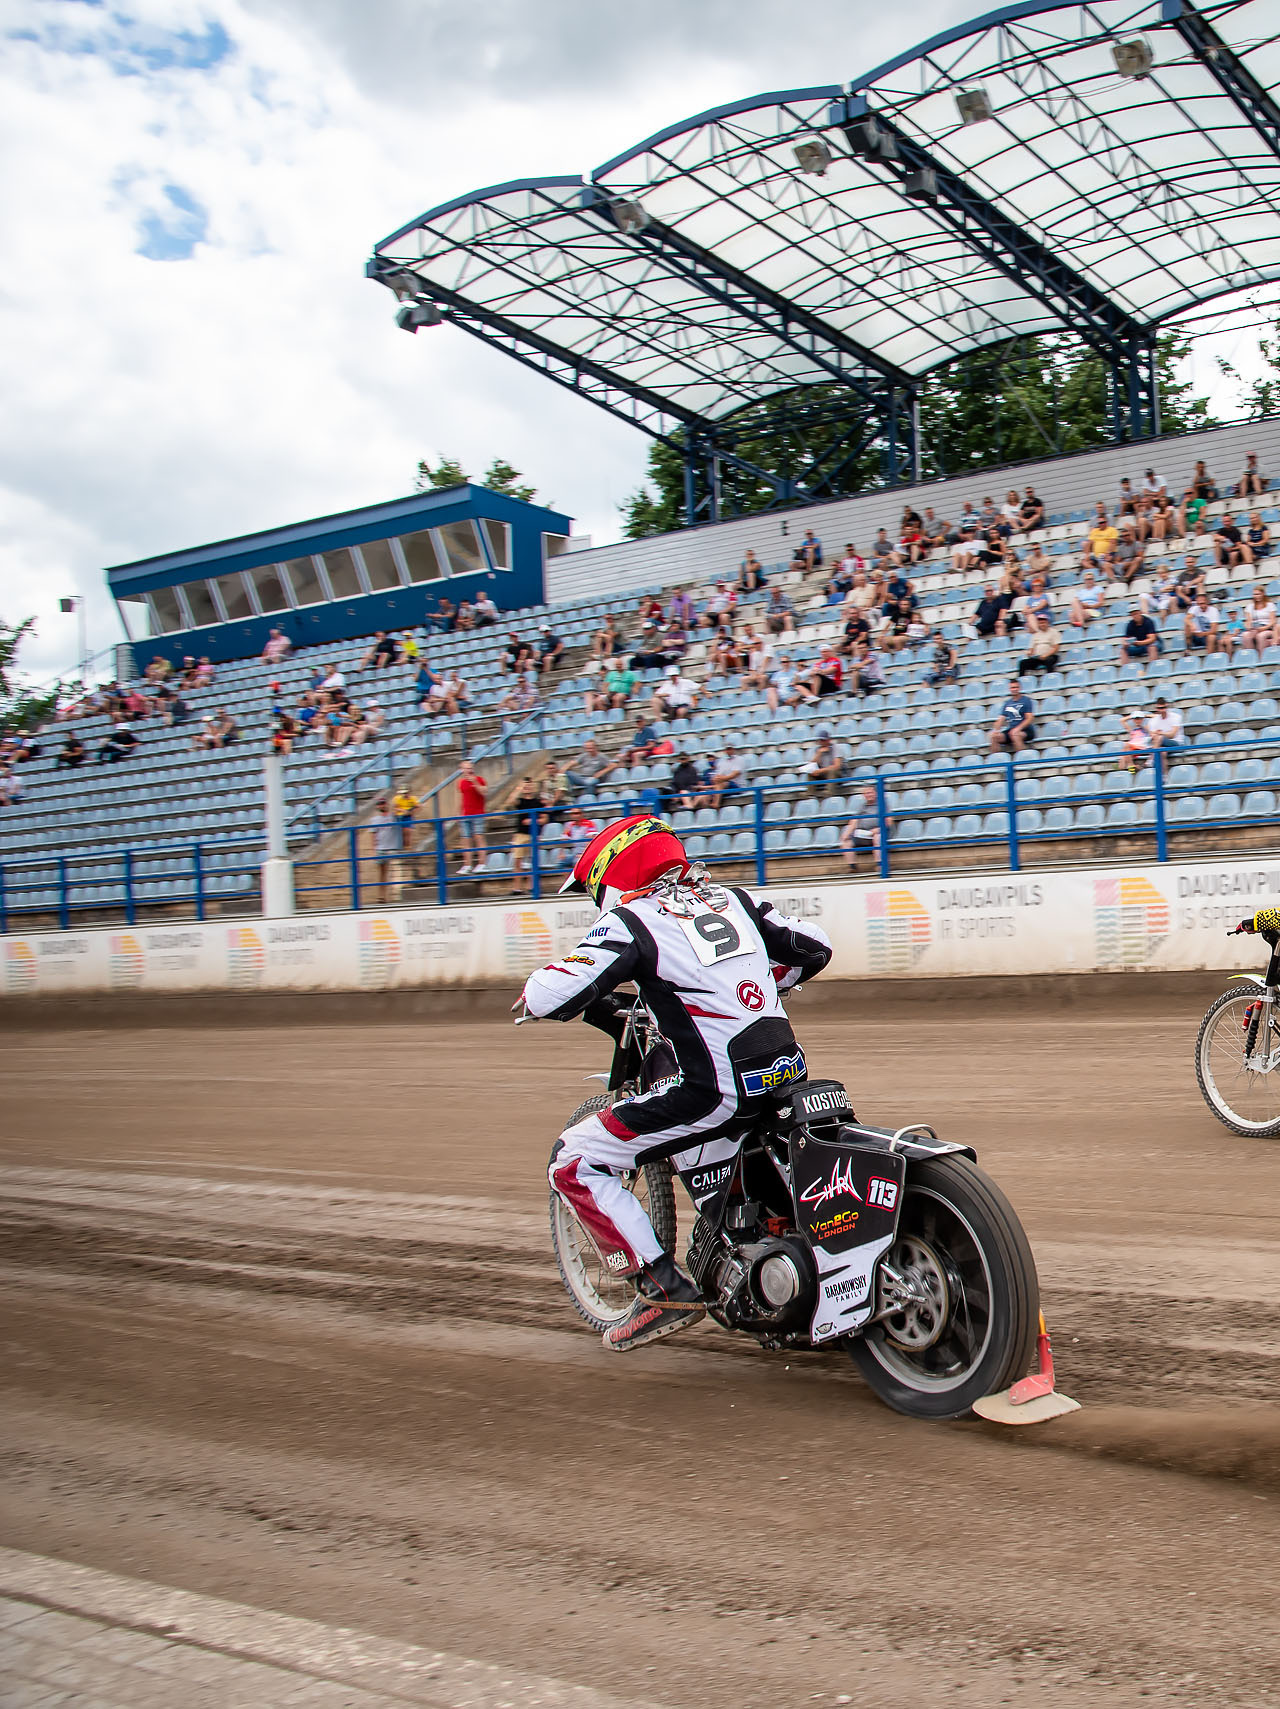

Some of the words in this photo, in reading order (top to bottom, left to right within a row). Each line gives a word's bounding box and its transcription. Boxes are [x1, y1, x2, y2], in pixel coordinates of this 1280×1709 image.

[694, 913, 740, 957] 9
[869, 1179, 897, 1208] 113
[818, 1222, 855, 1240] LONDON
[836, 1290, 862, 1303] FAMILY
